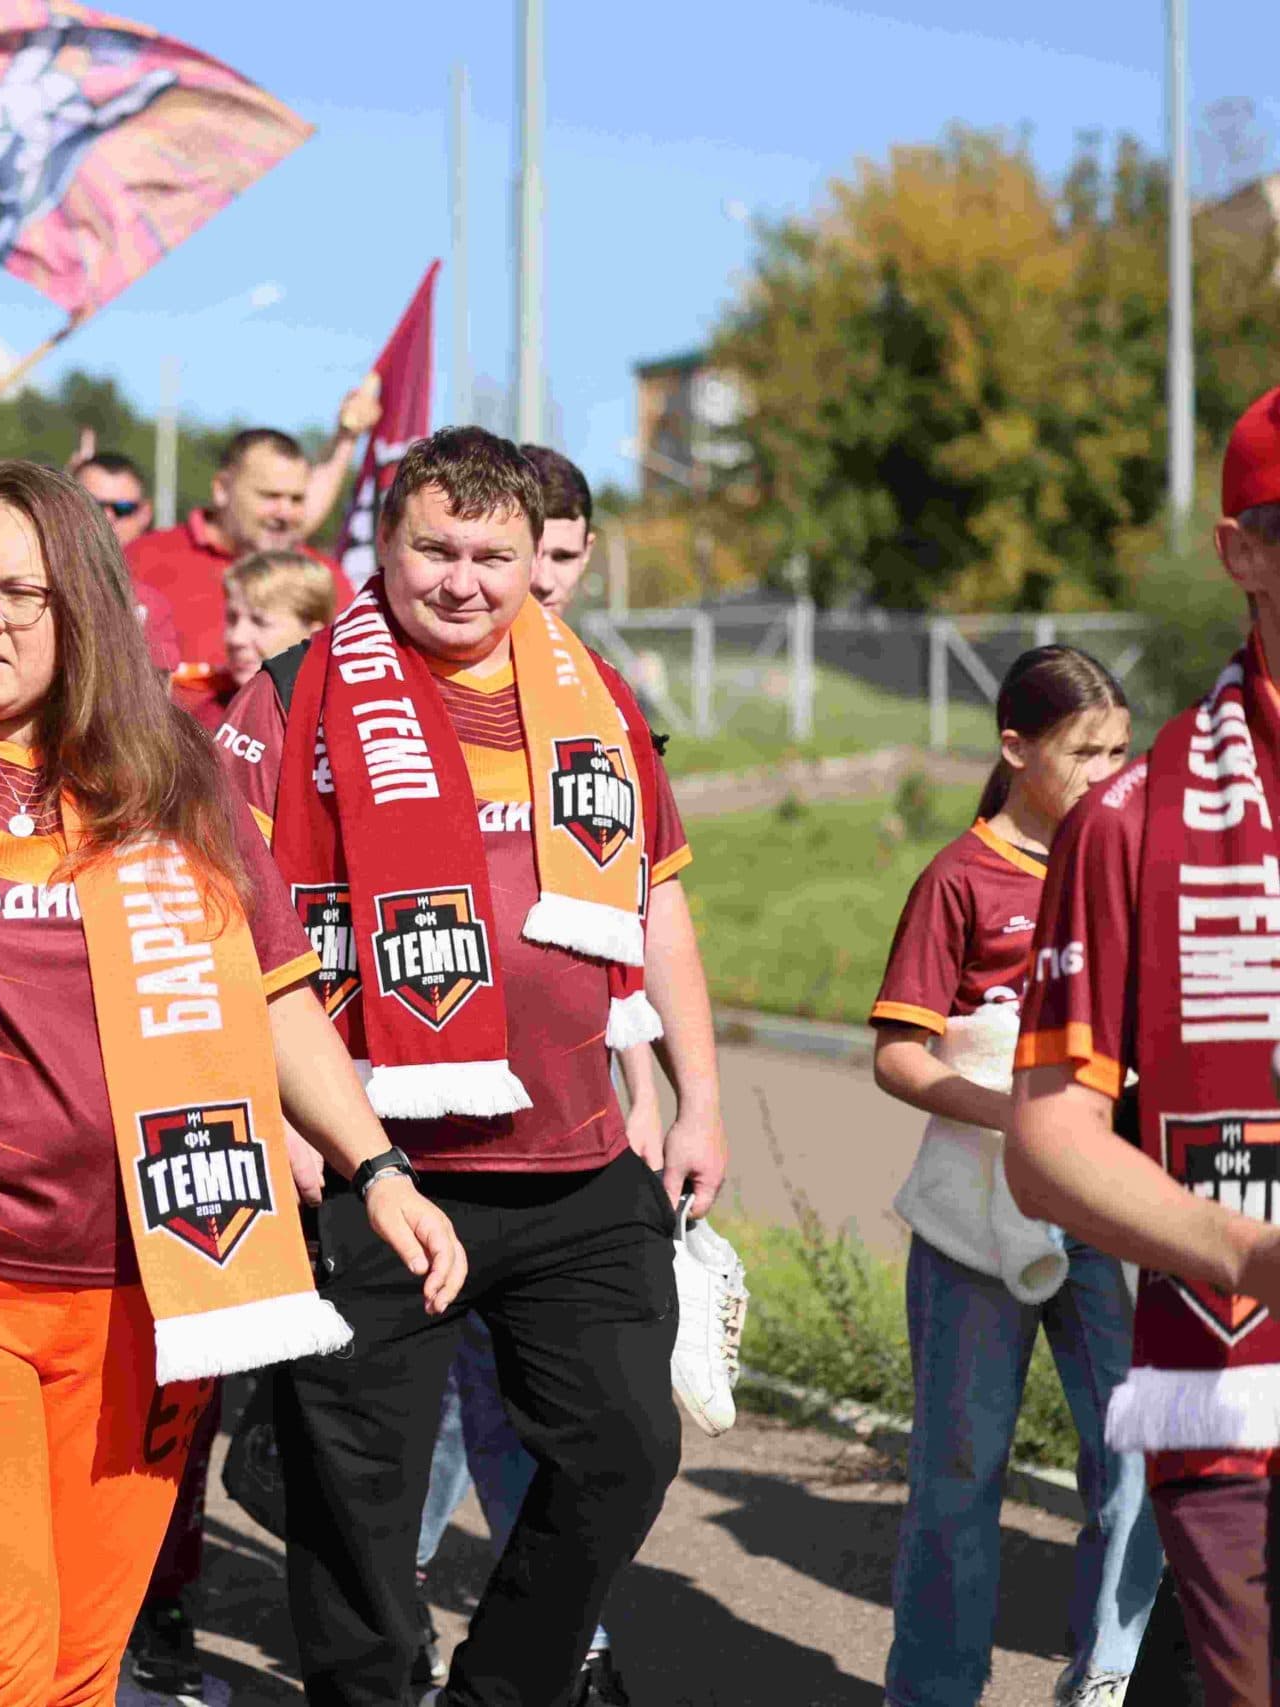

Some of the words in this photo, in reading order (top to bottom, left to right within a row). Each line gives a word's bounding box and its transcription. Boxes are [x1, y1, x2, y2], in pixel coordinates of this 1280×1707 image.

[214, 722, 266, 764] ПСБ
[352, 697, 440, 805] ТЕМП
[558, 773, 634, 827] ТЕМП
[322, 908, 340, 923] ФК
[414, 911, 437, 927] ФК
[383, 927, 481, 982] ТЕМП
[1179, 855, 1280, 1043] ТЕМП
[421, 974, 445, 985] 2020
[184, 1130, 211, 1148] ФК
[1215, 1150, 1251, 1176] ФК
[147, 1149, 261, 1215] ТЕМП
[196, 1203, 222, 1217] 2020
